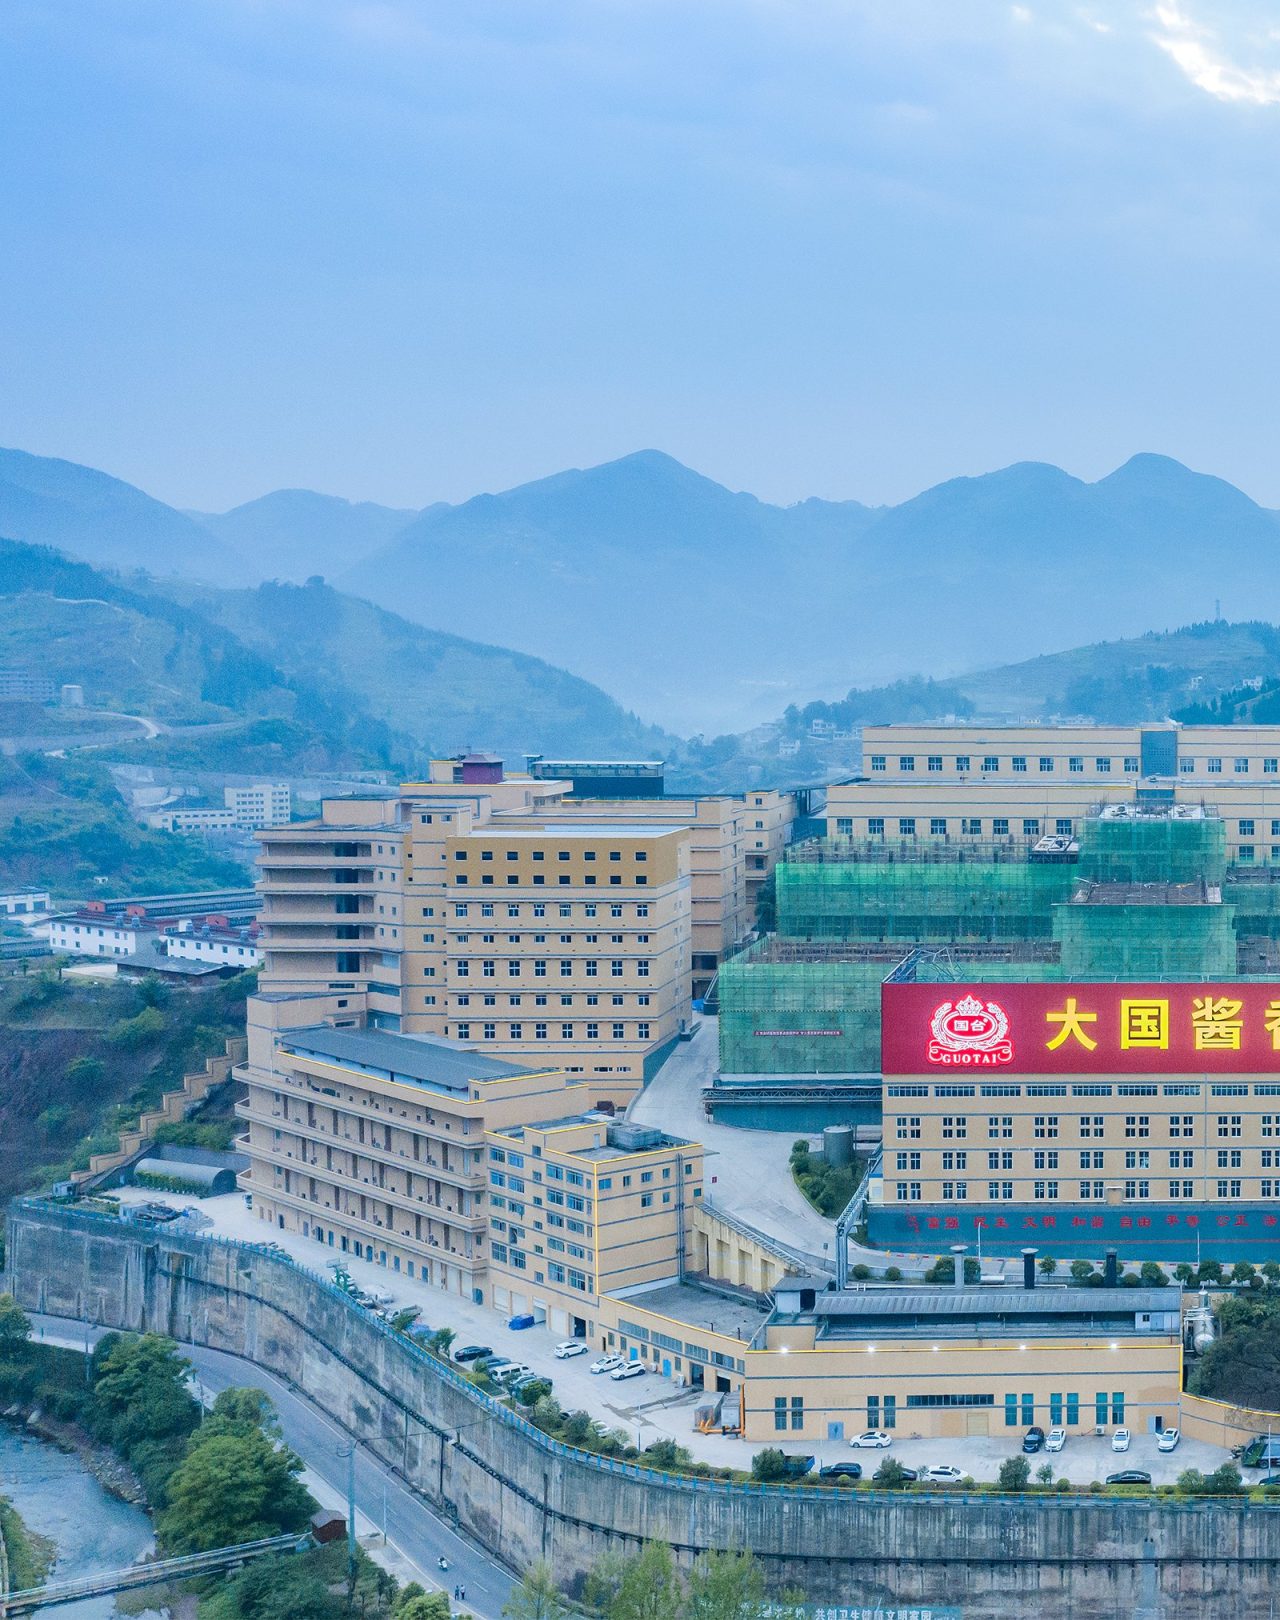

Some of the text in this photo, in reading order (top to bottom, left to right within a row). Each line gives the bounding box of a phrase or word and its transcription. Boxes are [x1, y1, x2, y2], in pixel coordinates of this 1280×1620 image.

[954, 1019, 985, 1032] 国台
[942, 1053, 997, 1064] GUOTAI
[1120, 1215, 1151, 1229] 自由
[1215, 1213, 1249, 1228] 公正
